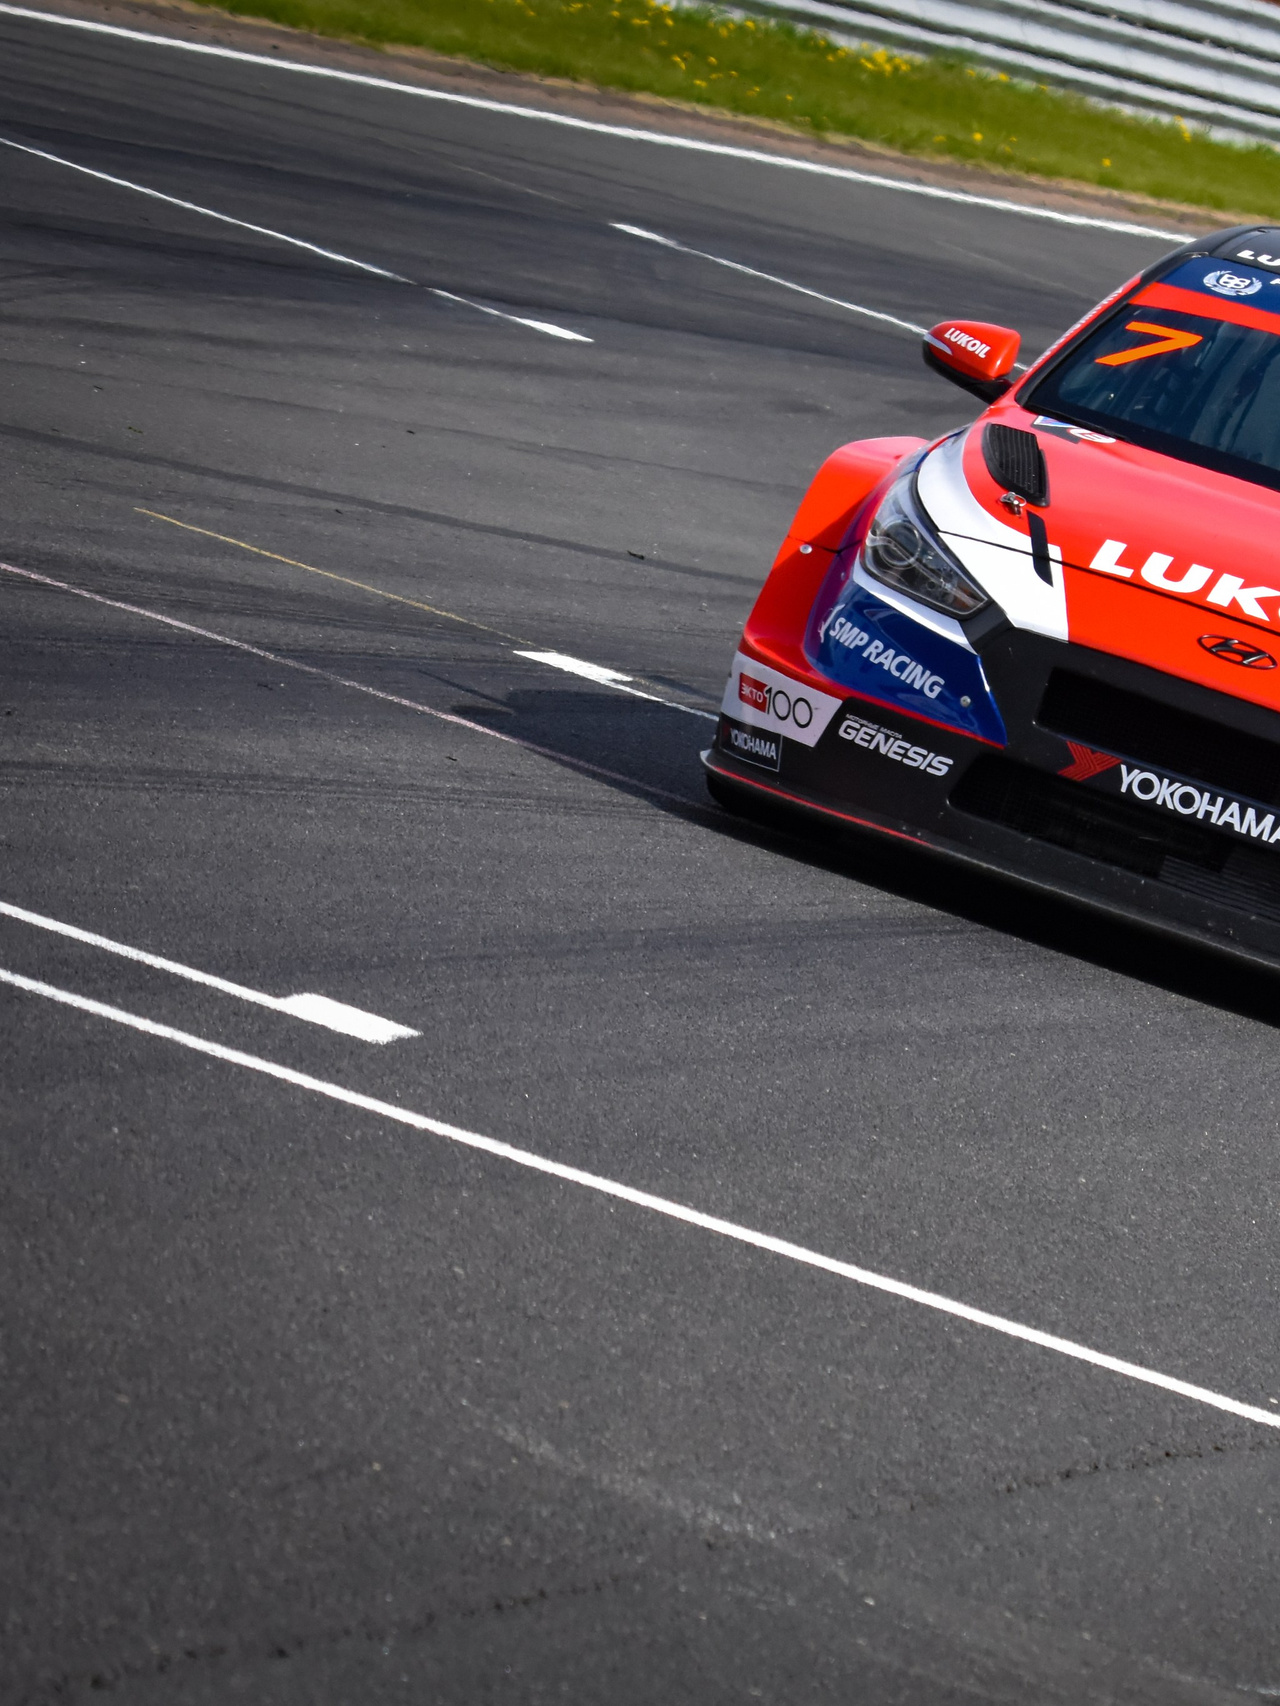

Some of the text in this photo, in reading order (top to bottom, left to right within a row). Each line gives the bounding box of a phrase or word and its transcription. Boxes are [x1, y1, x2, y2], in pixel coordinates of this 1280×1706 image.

[944, 327, 991, 359] LUKOIL
[1094, 321, 1203, 366] 7
[829, 616, 945, 699] SMP RACING
[741, 682, 813, 728] ЭКТО 100
[730, 727, 777, 760] YOKOHAMA
[838, 720, 953, 777] GENESIS
